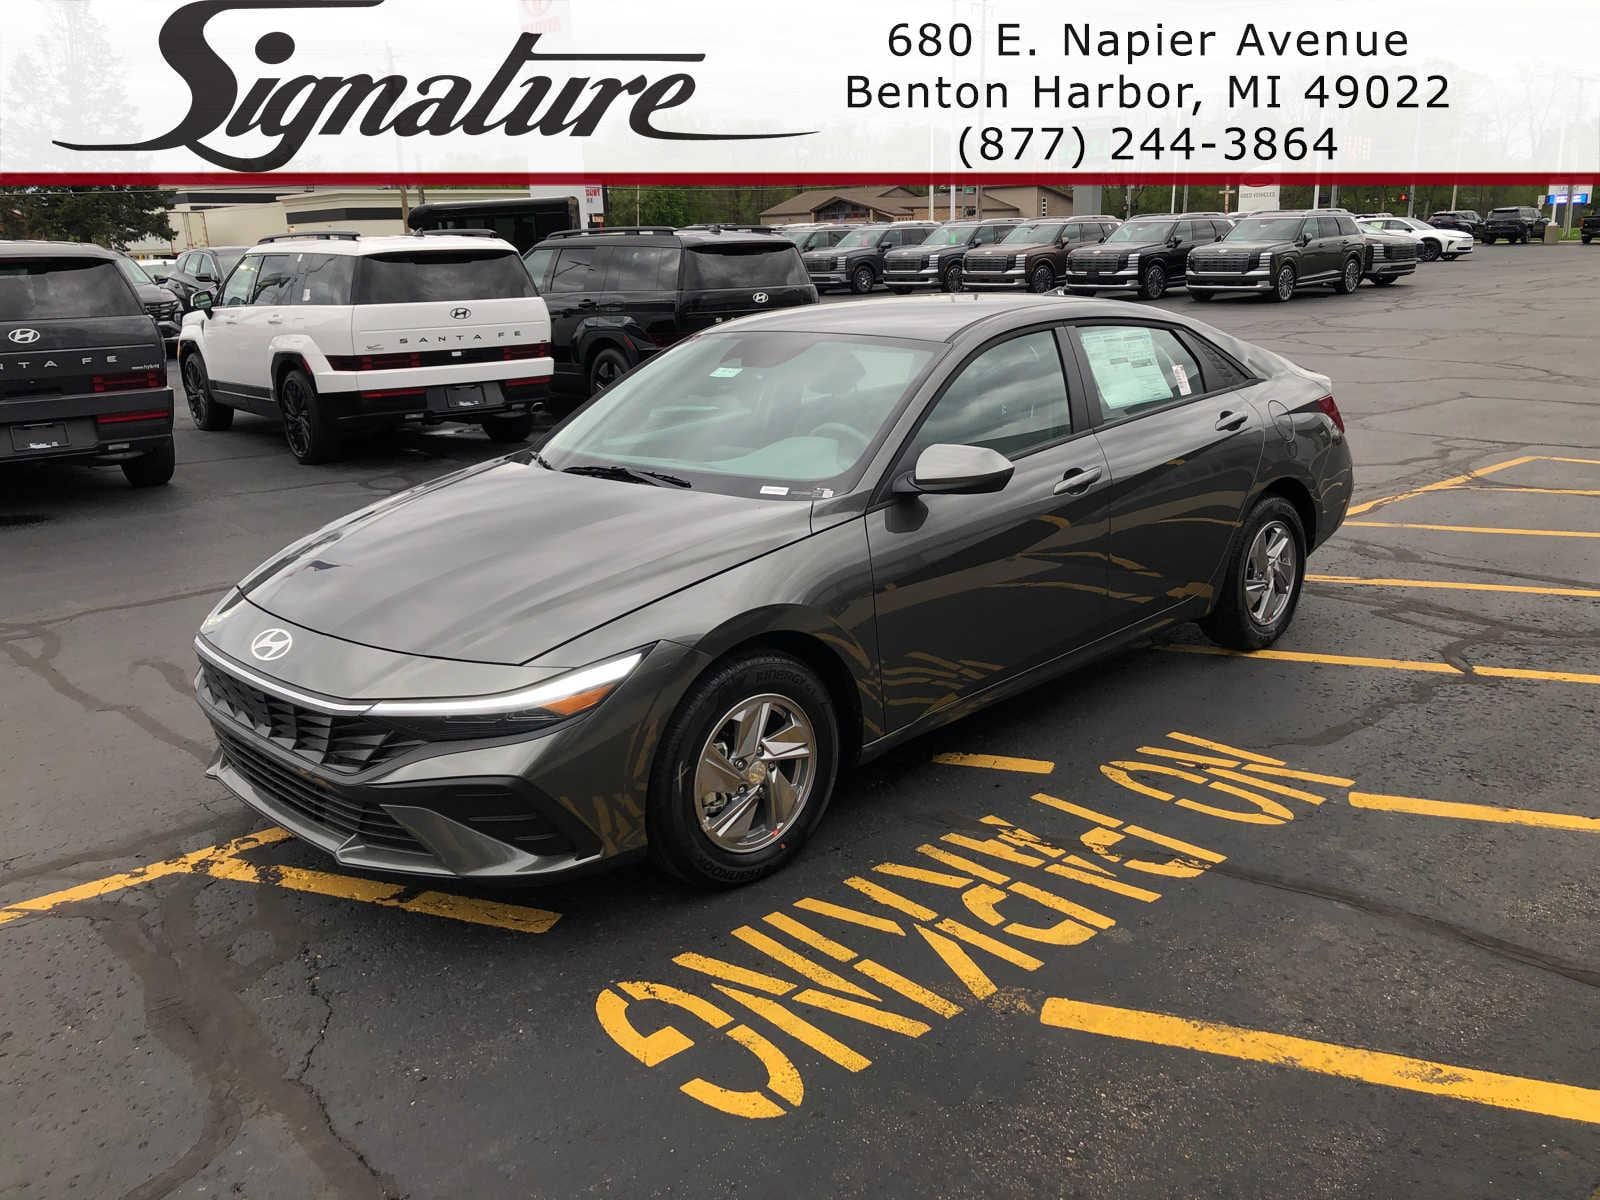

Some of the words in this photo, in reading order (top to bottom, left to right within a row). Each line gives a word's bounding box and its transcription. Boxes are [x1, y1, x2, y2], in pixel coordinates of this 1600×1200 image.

[0, 359, 59, 370] TA
[82, 355, 118, 365] FE
[399, 334, 482, 344] SANTA
[1100, 731, 1355, 826] NO
[595, 792, 1228, 1119] PARKING
